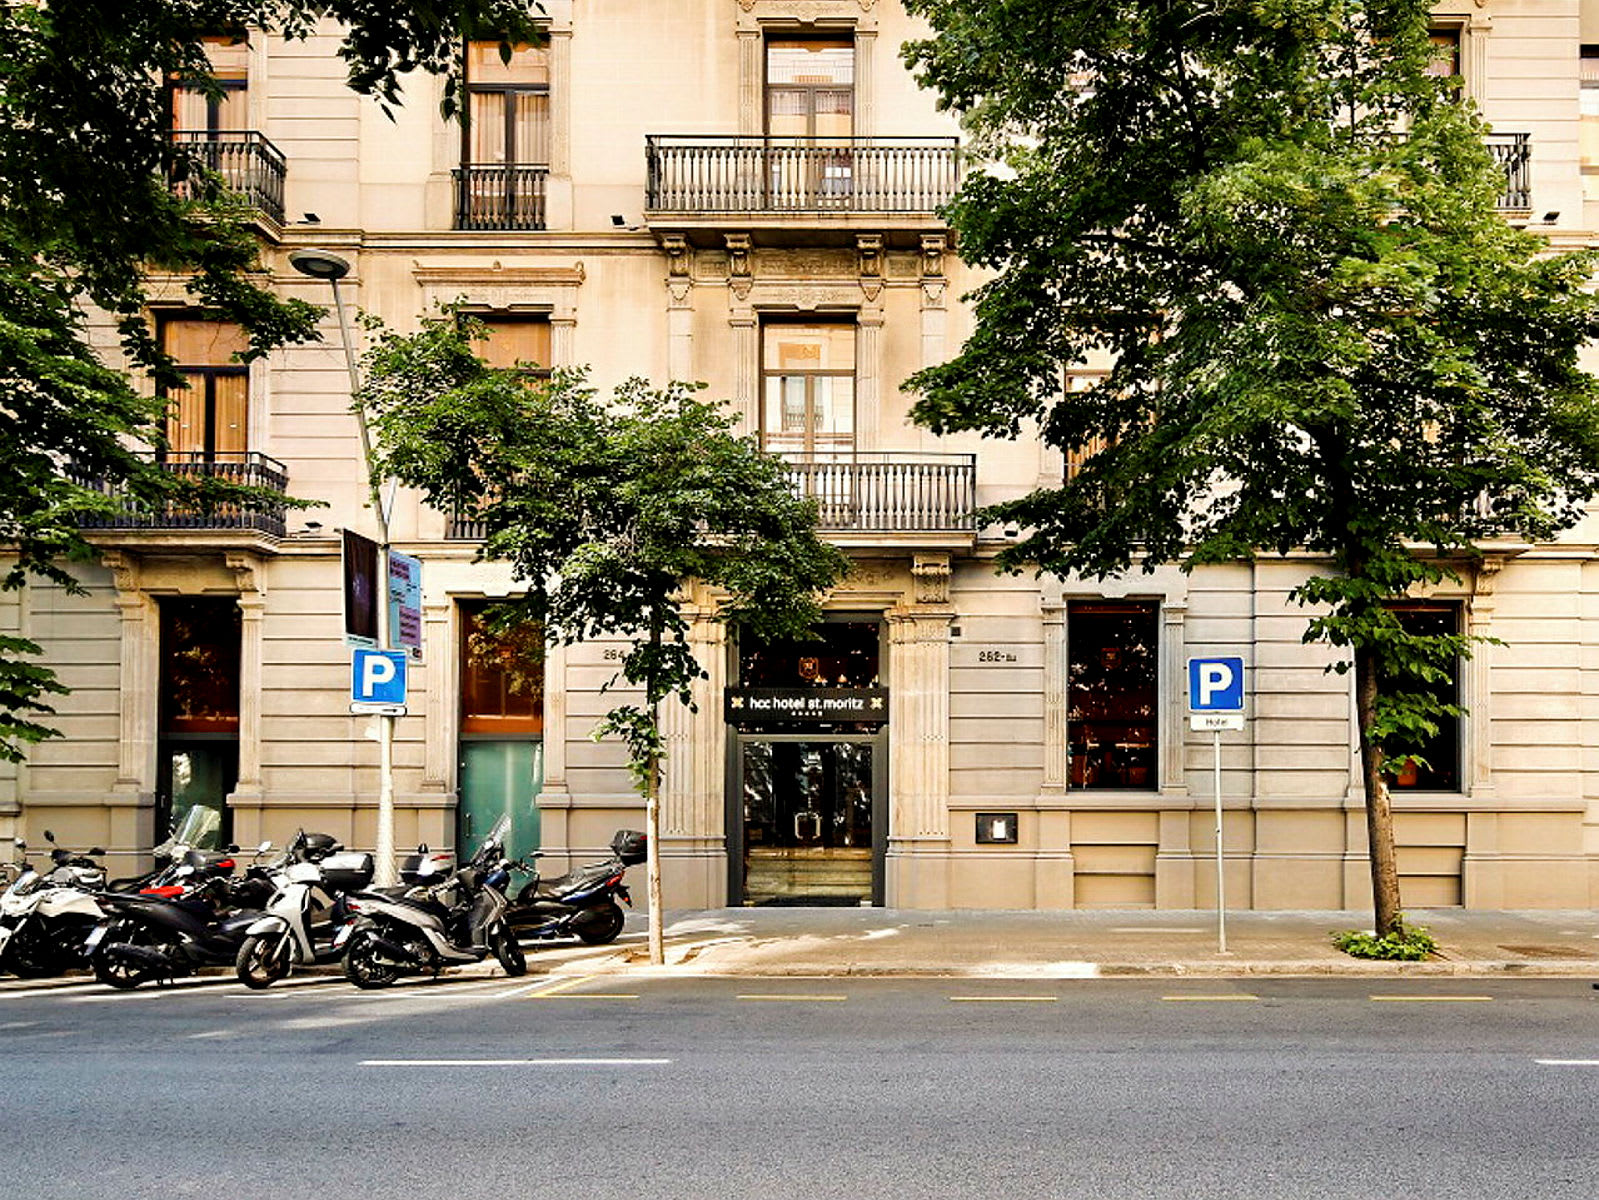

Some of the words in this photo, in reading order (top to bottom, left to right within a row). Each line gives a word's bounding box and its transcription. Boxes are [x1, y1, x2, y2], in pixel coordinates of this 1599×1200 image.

[362, 655, 396, 696] P
[1200, 663, 1233, 705] P
[750, 697, 771, 709] hcc
[773, 697, 805, 709] hotel
